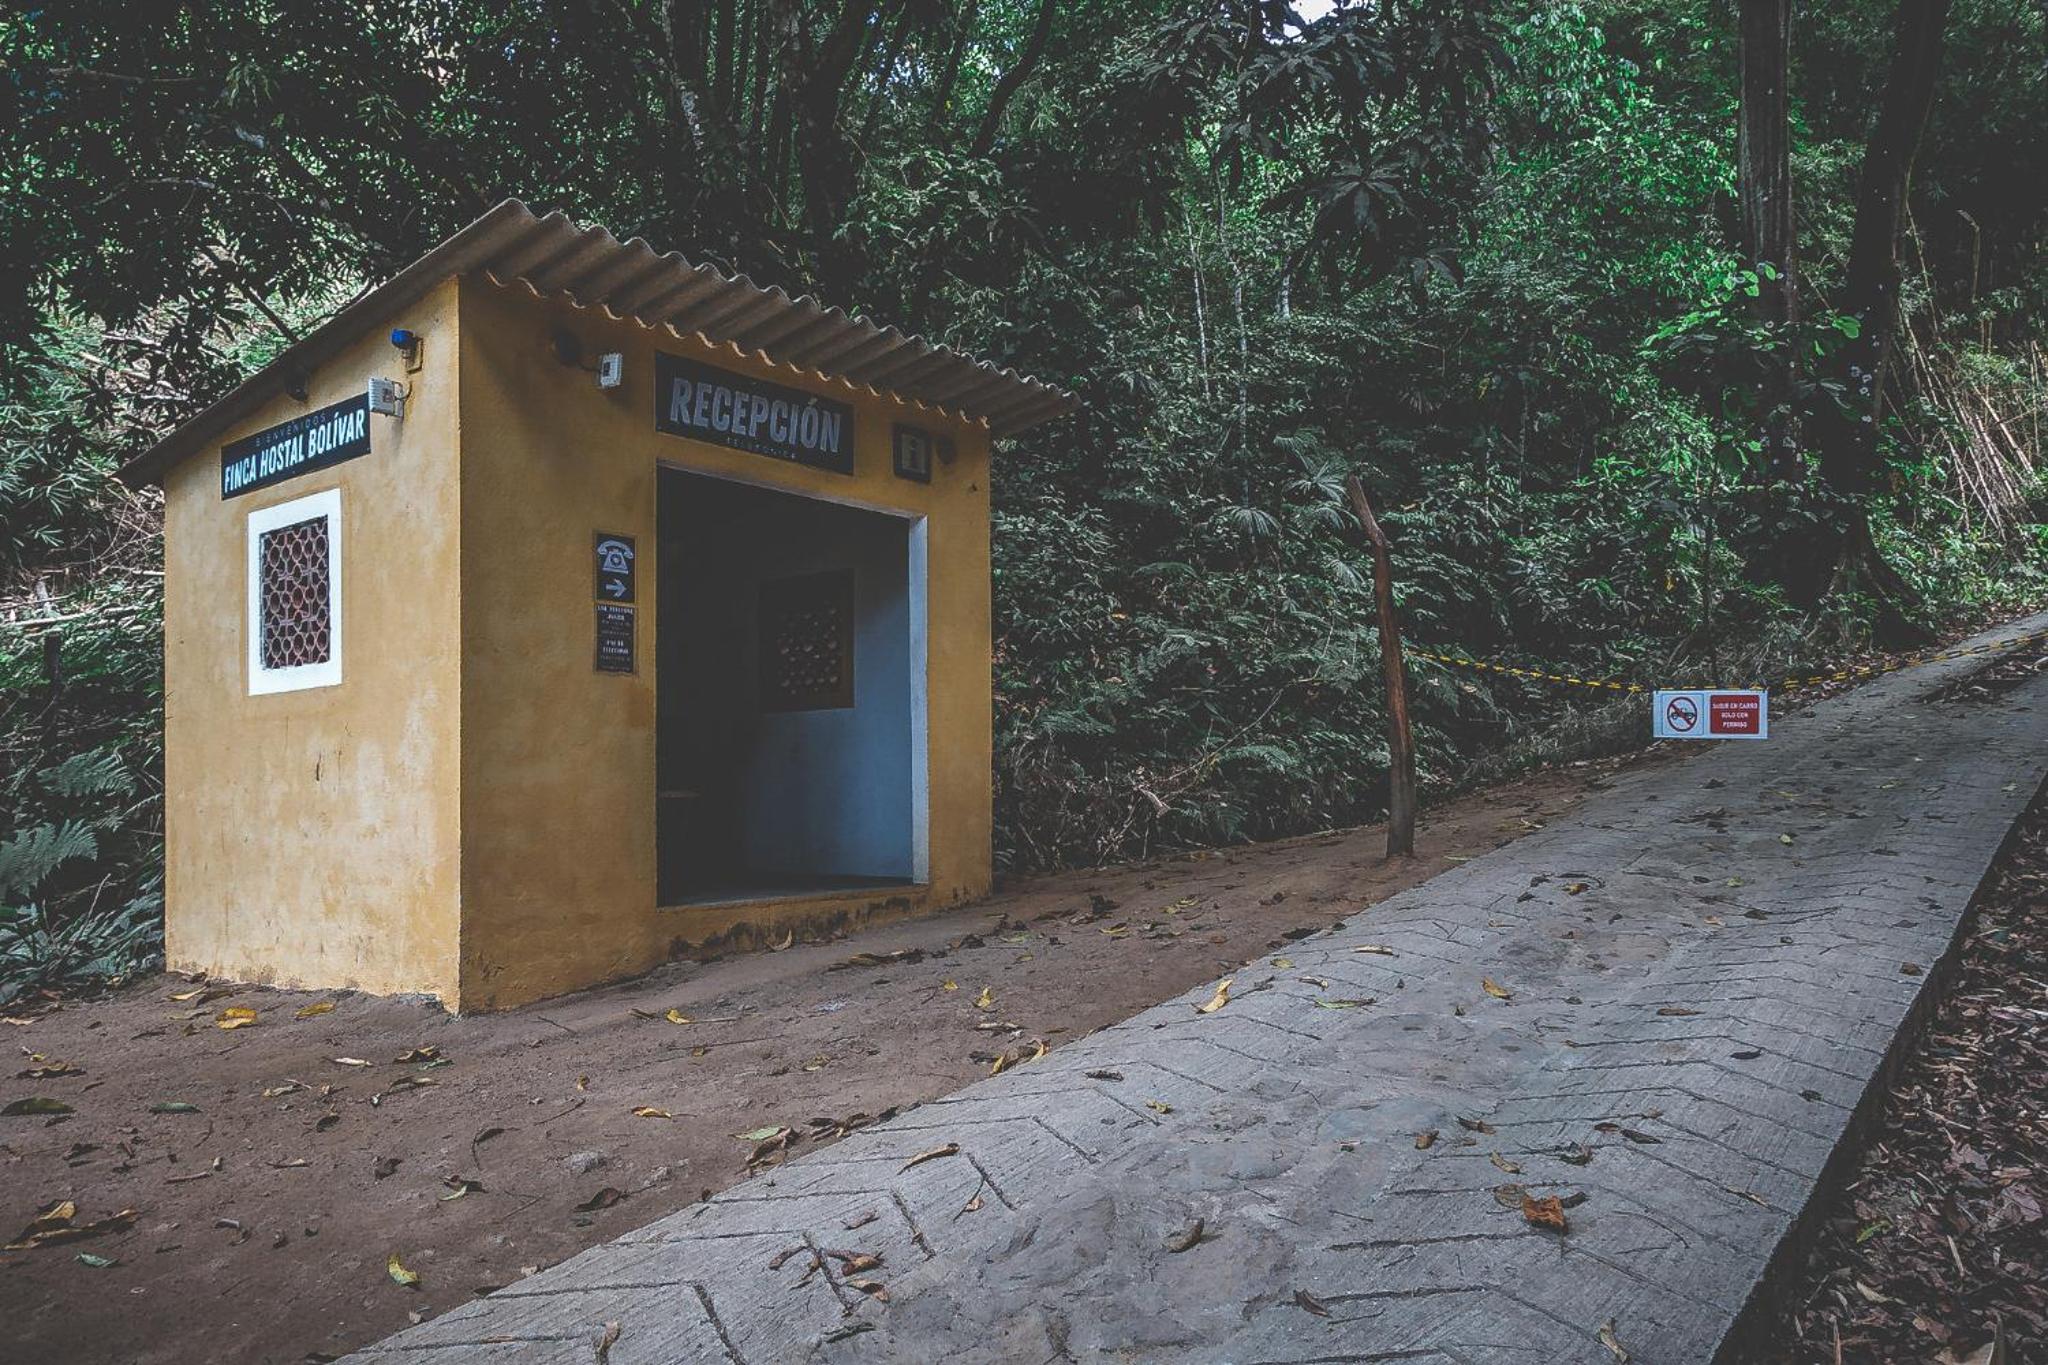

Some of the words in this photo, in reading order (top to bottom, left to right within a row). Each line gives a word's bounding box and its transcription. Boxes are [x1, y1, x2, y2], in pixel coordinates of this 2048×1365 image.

[224, 454, 257, 493] FINCA
[259, 434, 305, 478] HOSTAL
[307, 409, 366, 459] BOLÍVAR
[669, 376, 841, 453] RECEPCIÓN
